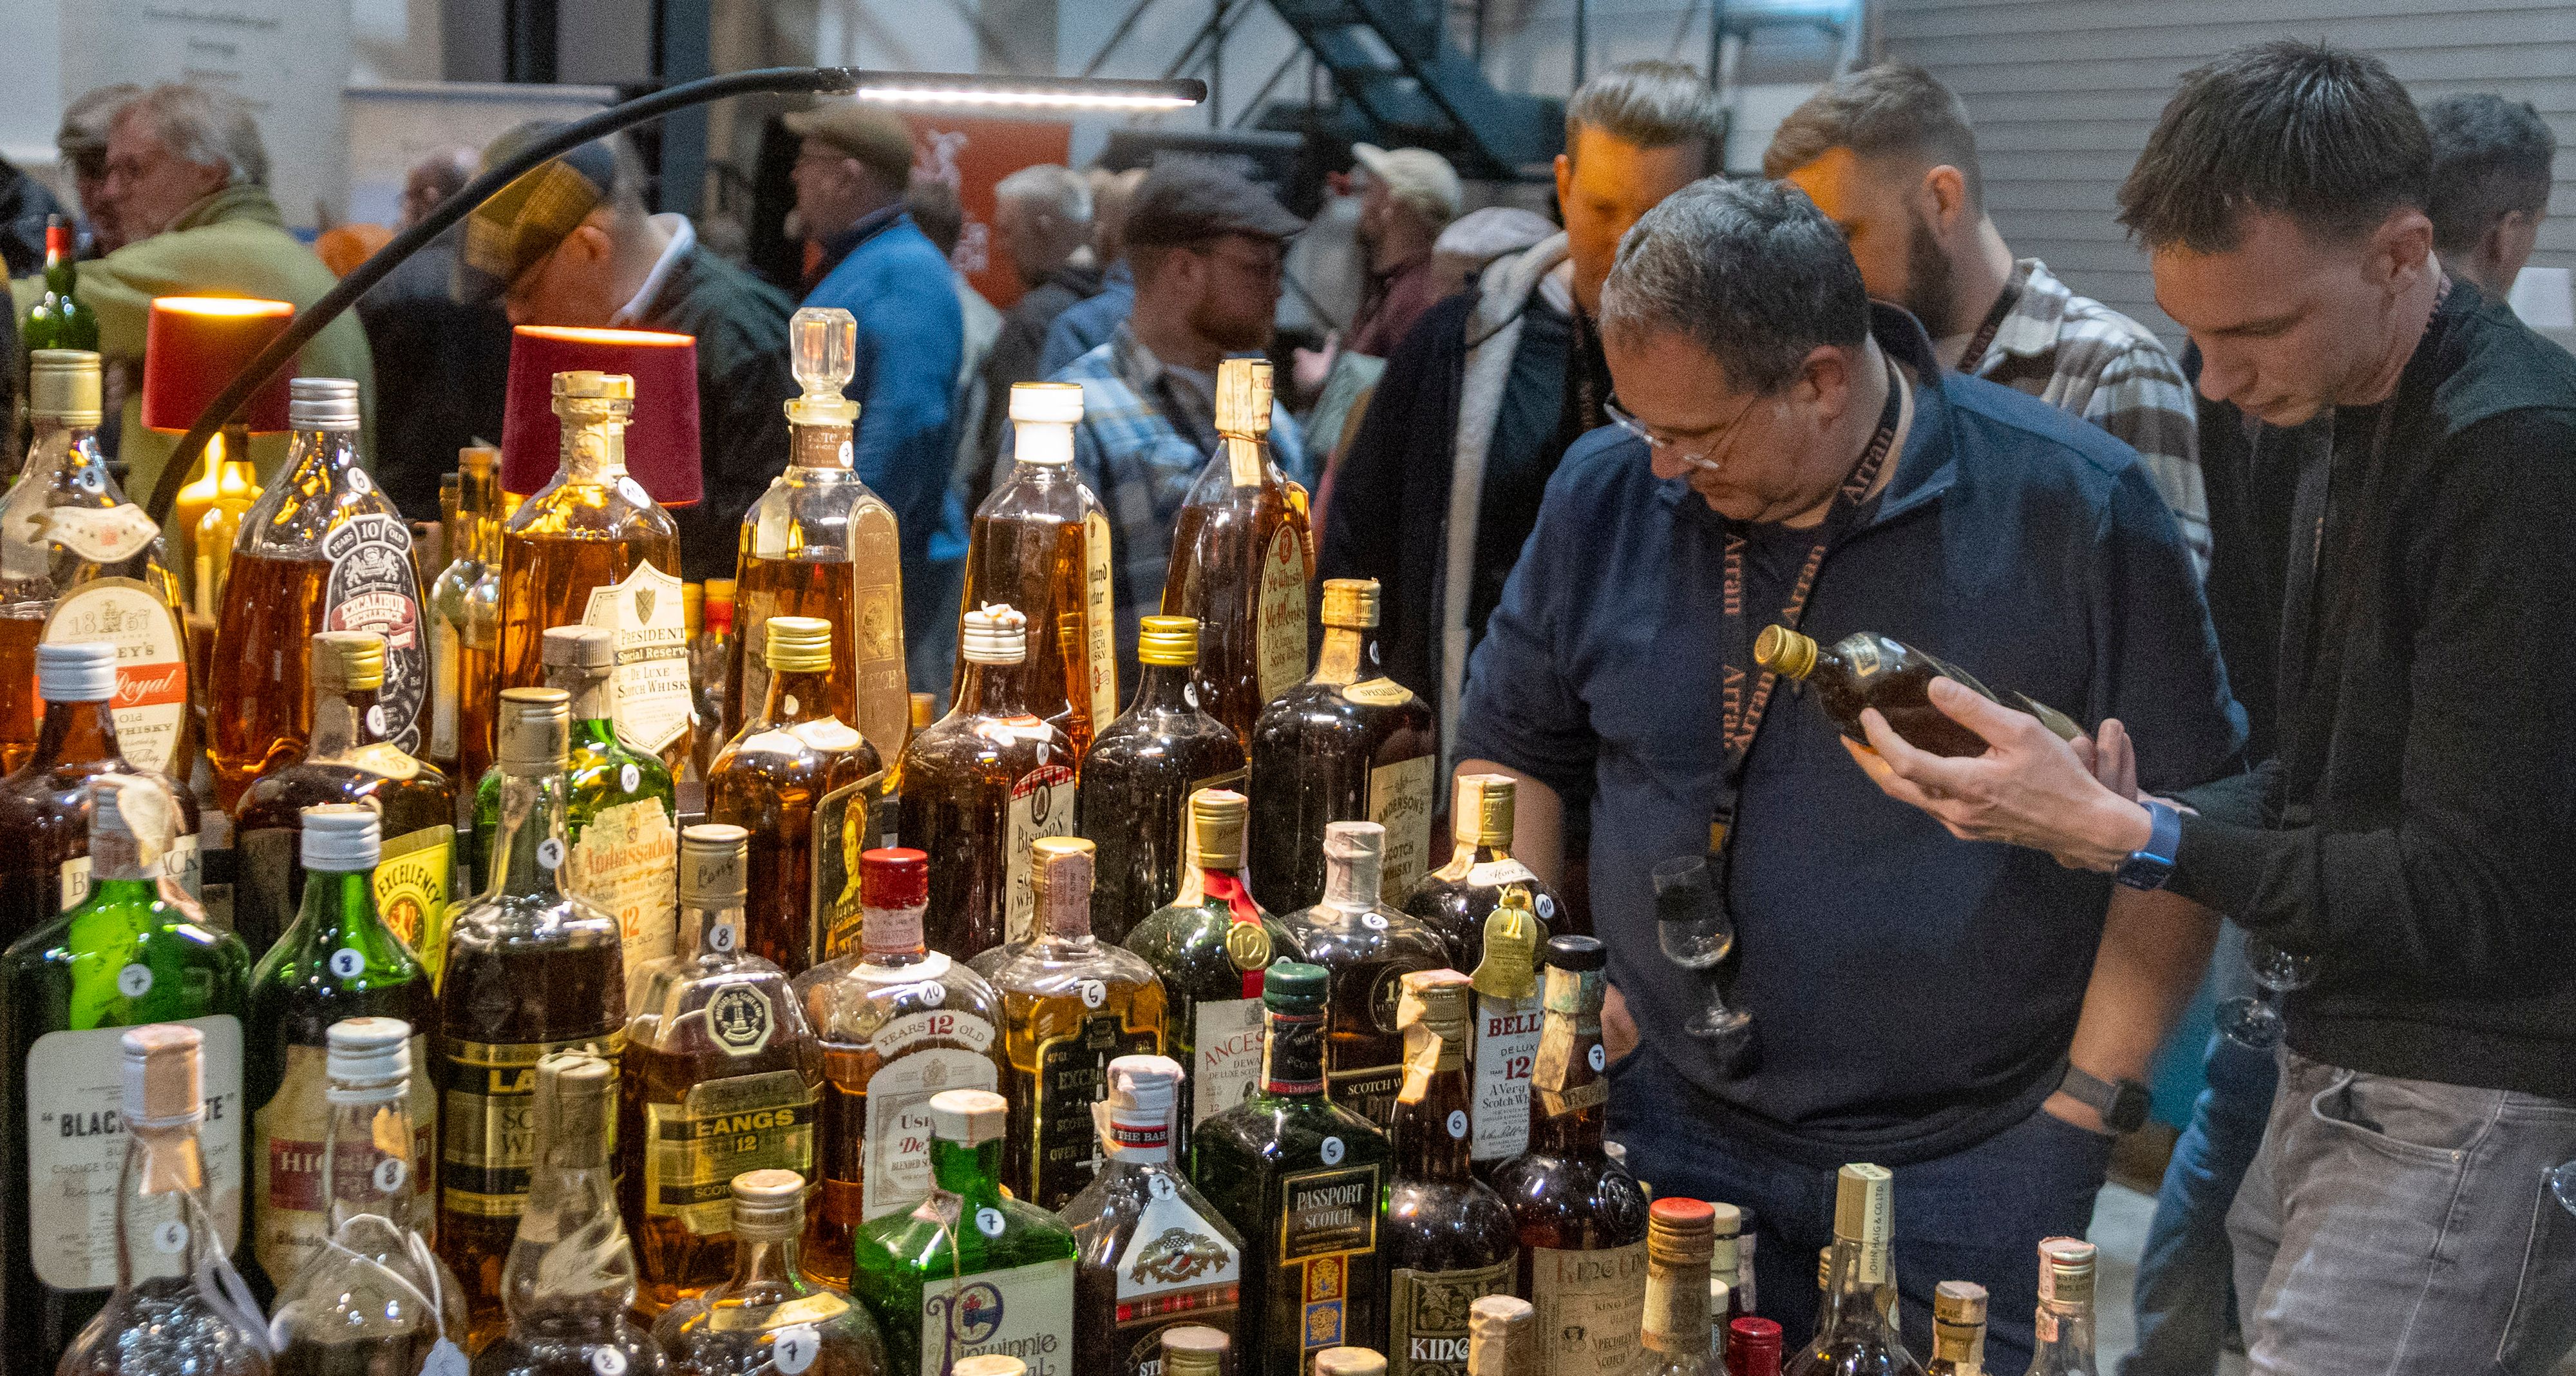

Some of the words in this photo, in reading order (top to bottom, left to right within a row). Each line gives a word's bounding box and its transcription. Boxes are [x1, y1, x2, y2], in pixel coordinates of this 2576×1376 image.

[1843, 424, 1894, 506] Arran
[355, 470, 366, 488] 6
[330, 530, 354, 553] YEARS
[361, 522, 379, 539] 10
[388, 530, 404, 543] OLD
[1723, 533, 1747, 616] Arran
[1781, 544, 1826, 626] Arran
[341, 594, 406, 621] EXCALIBUR
[69, 610, 96, 636] 18
[345, 609, 403, 631] EXCELLENCE
[621, 627, 685, 645] PRESIDENT
[118, 642, 155, 658] EY'S
[618, 649, 643, 665] Special
[644, 667, 670, 678] LUXE
[115, 669, 176, 705] Royal
[618, 684, 646, 698] SCOTCH
[118, 712, 143, 723] Old
[1732, 670, 1776, 754] Arran
[1377, 794, 1425, 823] ANDERSON'S
[377, 863, 441, 904] EXCELLENCY
[1540, 899, 1551, 913] 10
[621, 906, 640, 939] 12
[638, 934, 654, 944] OLD
[717, 928, 729, 946] 8
[1237, 933, 1263, 959] 12
[923, 986, 940, 1000] 10
[880, 1022, 926, 1047] YEARS
[927, 1015, 955, 1036] 12
[959, 1024, 985, 1042] OLD
[1487, 1009, 1546, 1038] BELL'
[1204, 1030, 1264, 1071] ANCES
[1501, 1047, 1515, 1056] DE
[1517, 1042, 1536, 1053] LUX
[1593, 1051, 1604, 1064] 7
[1233, 1057, 1261, 1069] DEWA
[1506, 1056, 1531, 1081] 12
[1220, 1069, 1239, 1078] LUXE
[1348, 1080, 1390, 1095] SCOTCH
[1489, 1084, 1497, 1096] A
[1499, 1082, 1526, 1095] Very
[1209, 1104, 1220, 1113] 12
[1482, 1096, 1513, 1109] Scotch
[1454, 1116, 1461, 1129] 6
[736, 1135, 757, 1153] 12
[899, 1136, 923, 1155] De
[1118, 1131, 1141, 1142] THE
[1157, 1178, 1170, 1194] 7
[1296, 1183, 1365, 1211] PASSPORT
[981, 1213, 997, 1230] 7
[1305, 1207, 1353, 1230] SCOTCH
[1871, 1225, 1881, 1248] HAIG
[1868, 1252, 1879, 1276] JOHN
[600, 1352, 611, 1368] 8
[786, 1341, 799, 1362] 7
